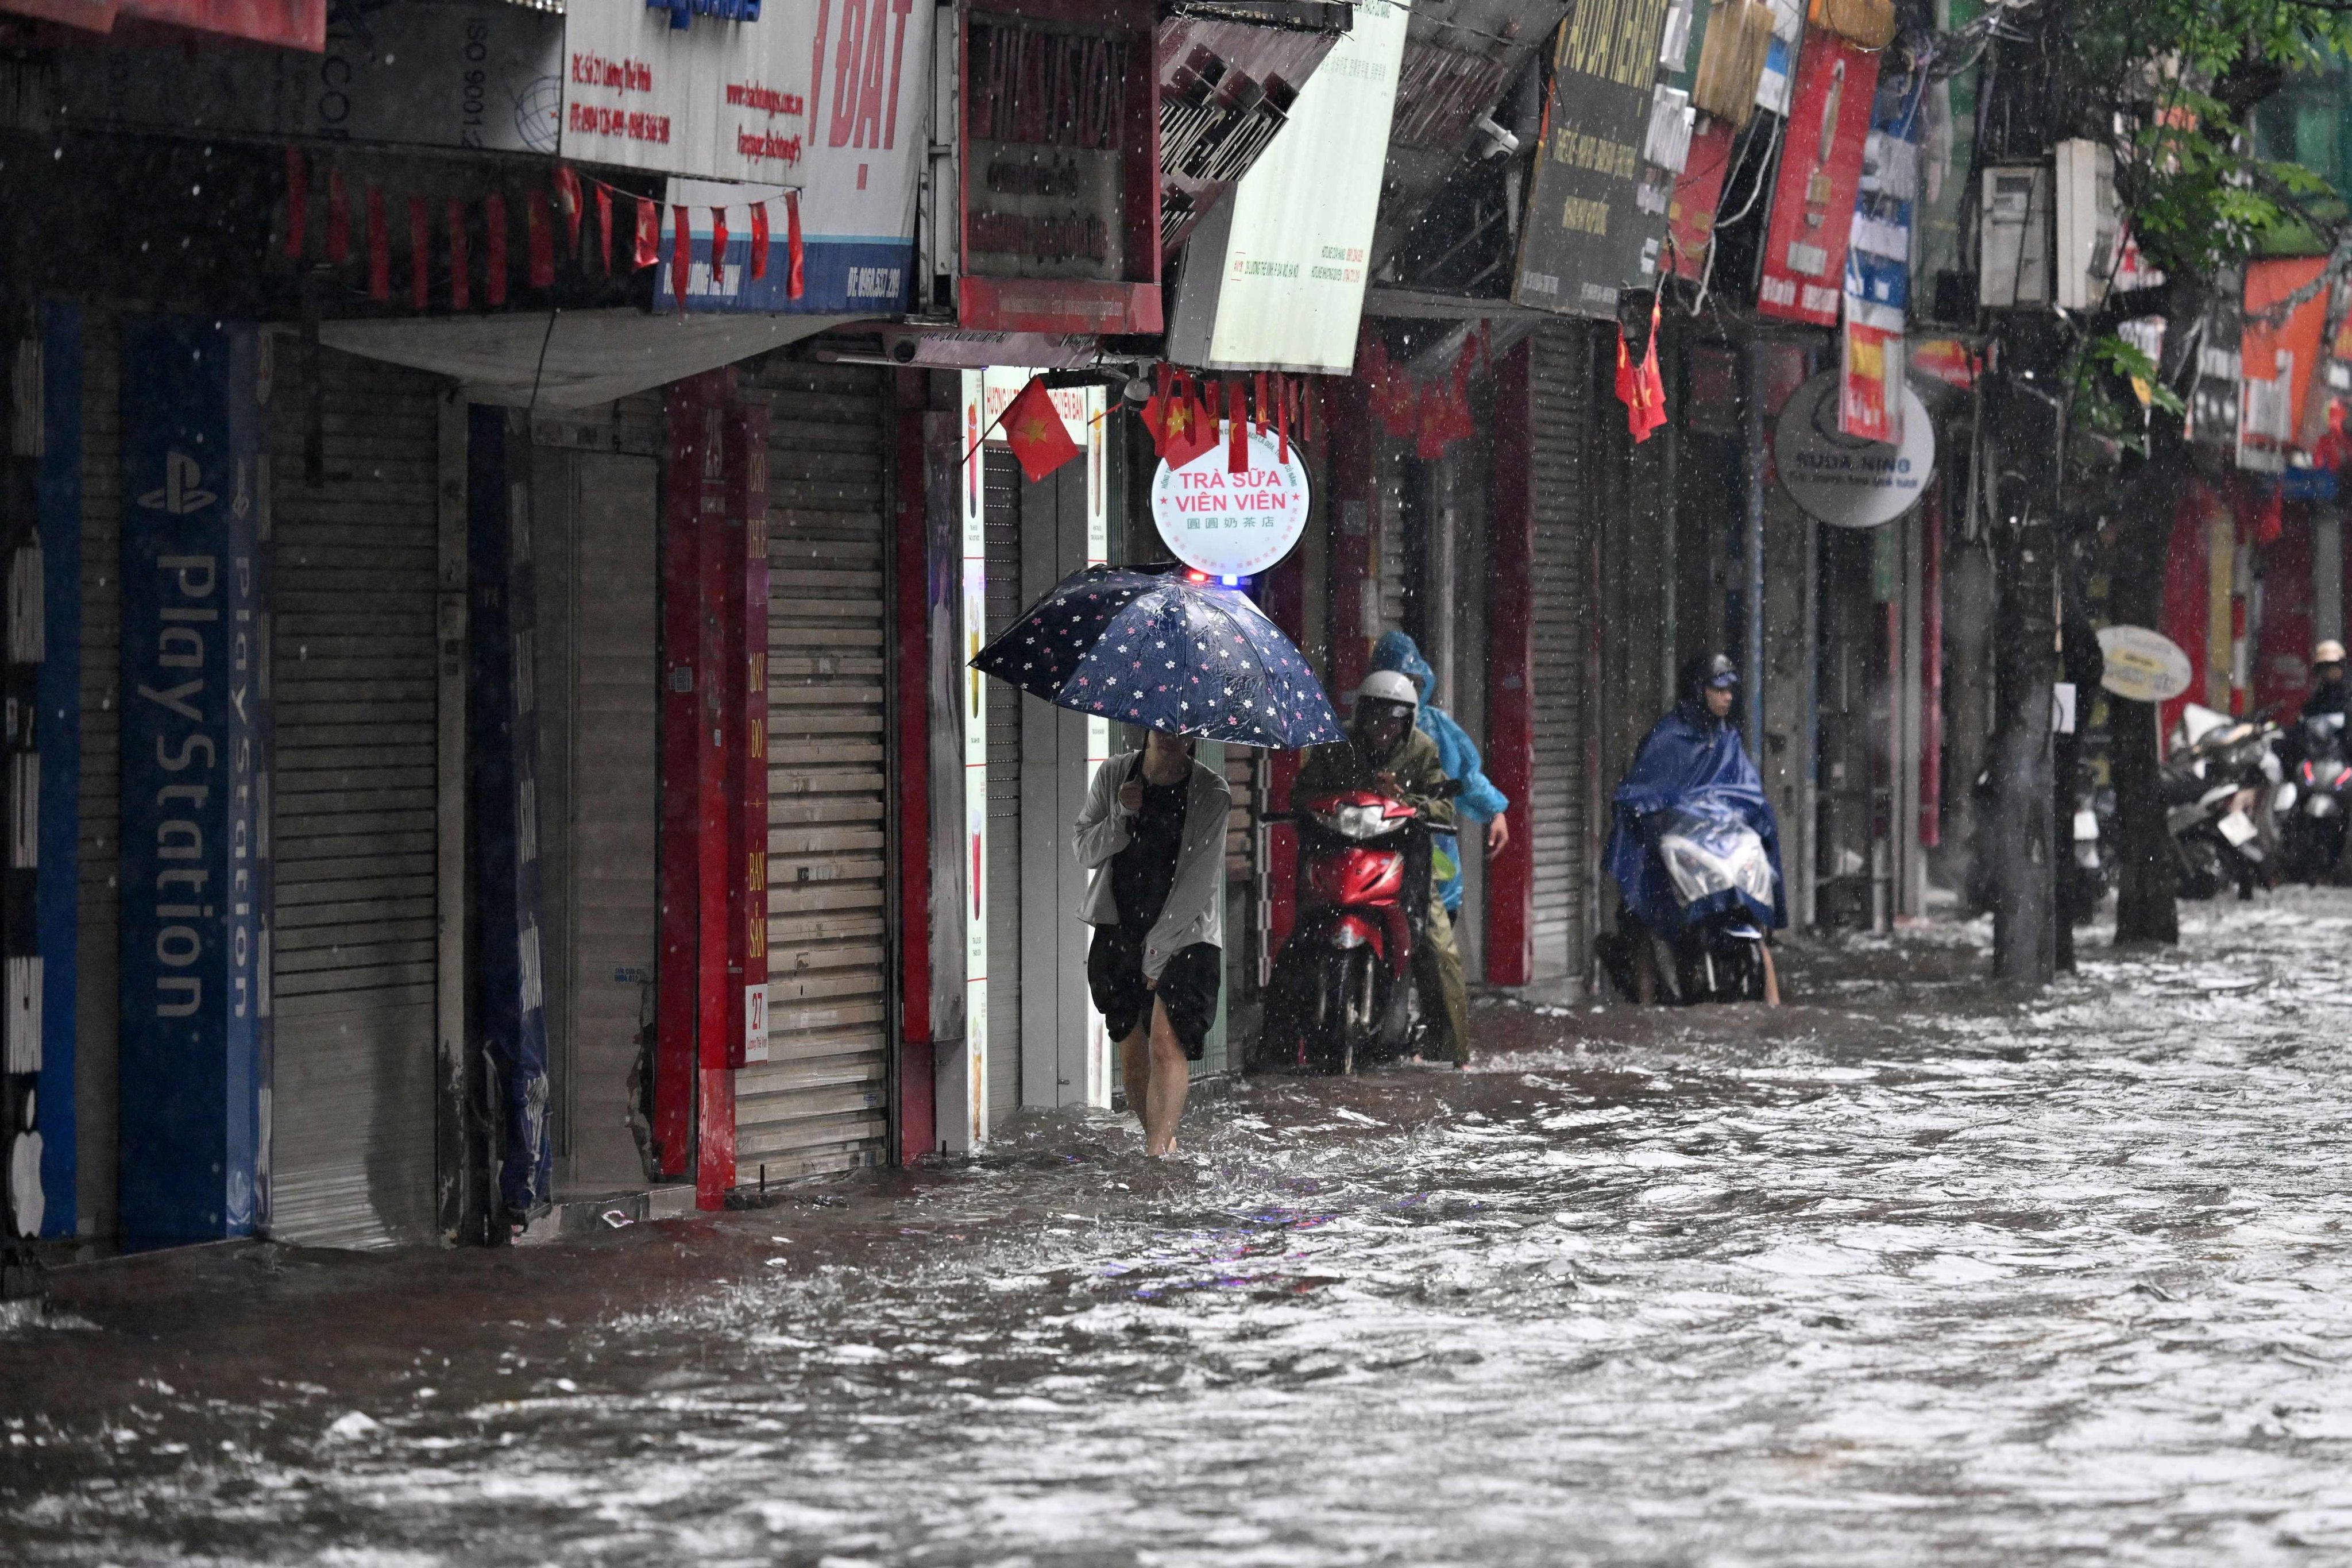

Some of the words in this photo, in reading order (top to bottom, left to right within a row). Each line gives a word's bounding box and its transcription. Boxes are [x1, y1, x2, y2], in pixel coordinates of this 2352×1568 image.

[750, 451, 765, 493] CHO
[1179, 468, 1225, 489] TRÀ
[1232, 467, 1281, 488] SỮA
[1175, 491, 1227, 512] VIÊN
[1234, 490, 1287, 511] VIÊN
[749, 652, 765, 693] MAY
[138, 555, 218, 1018] PlayStation
[230, 556, 250, 1019] PlayStation
[749, 839, 764, 892] BÁN
[752, 992, 763, 1030] 27
